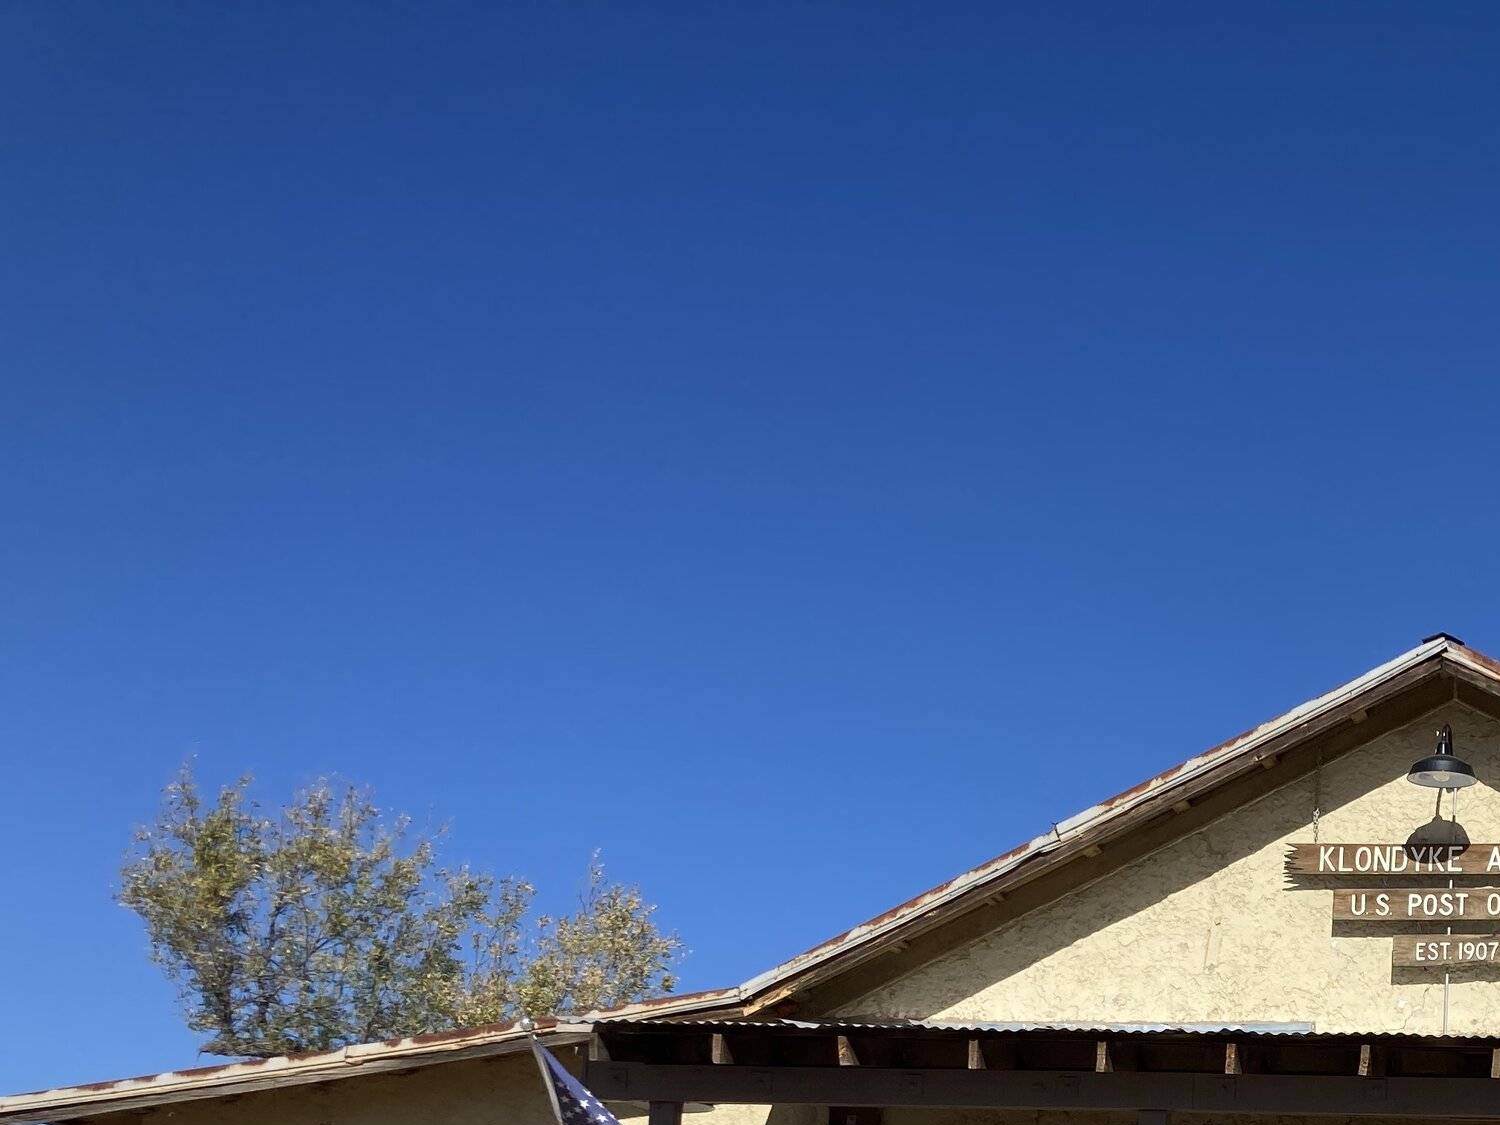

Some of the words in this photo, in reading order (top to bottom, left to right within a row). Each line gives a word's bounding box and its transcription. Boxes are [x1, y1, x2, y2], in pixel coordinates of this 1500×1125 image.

[1318, 845, 1464, 872] KLONDYKE
[1350, 894, 1393, 916] U.S.
[1407, 893, 1470, 917] POST
[1415, 942, 1452, 962] EST.
[1458, 942, 1499, 961] 1907
